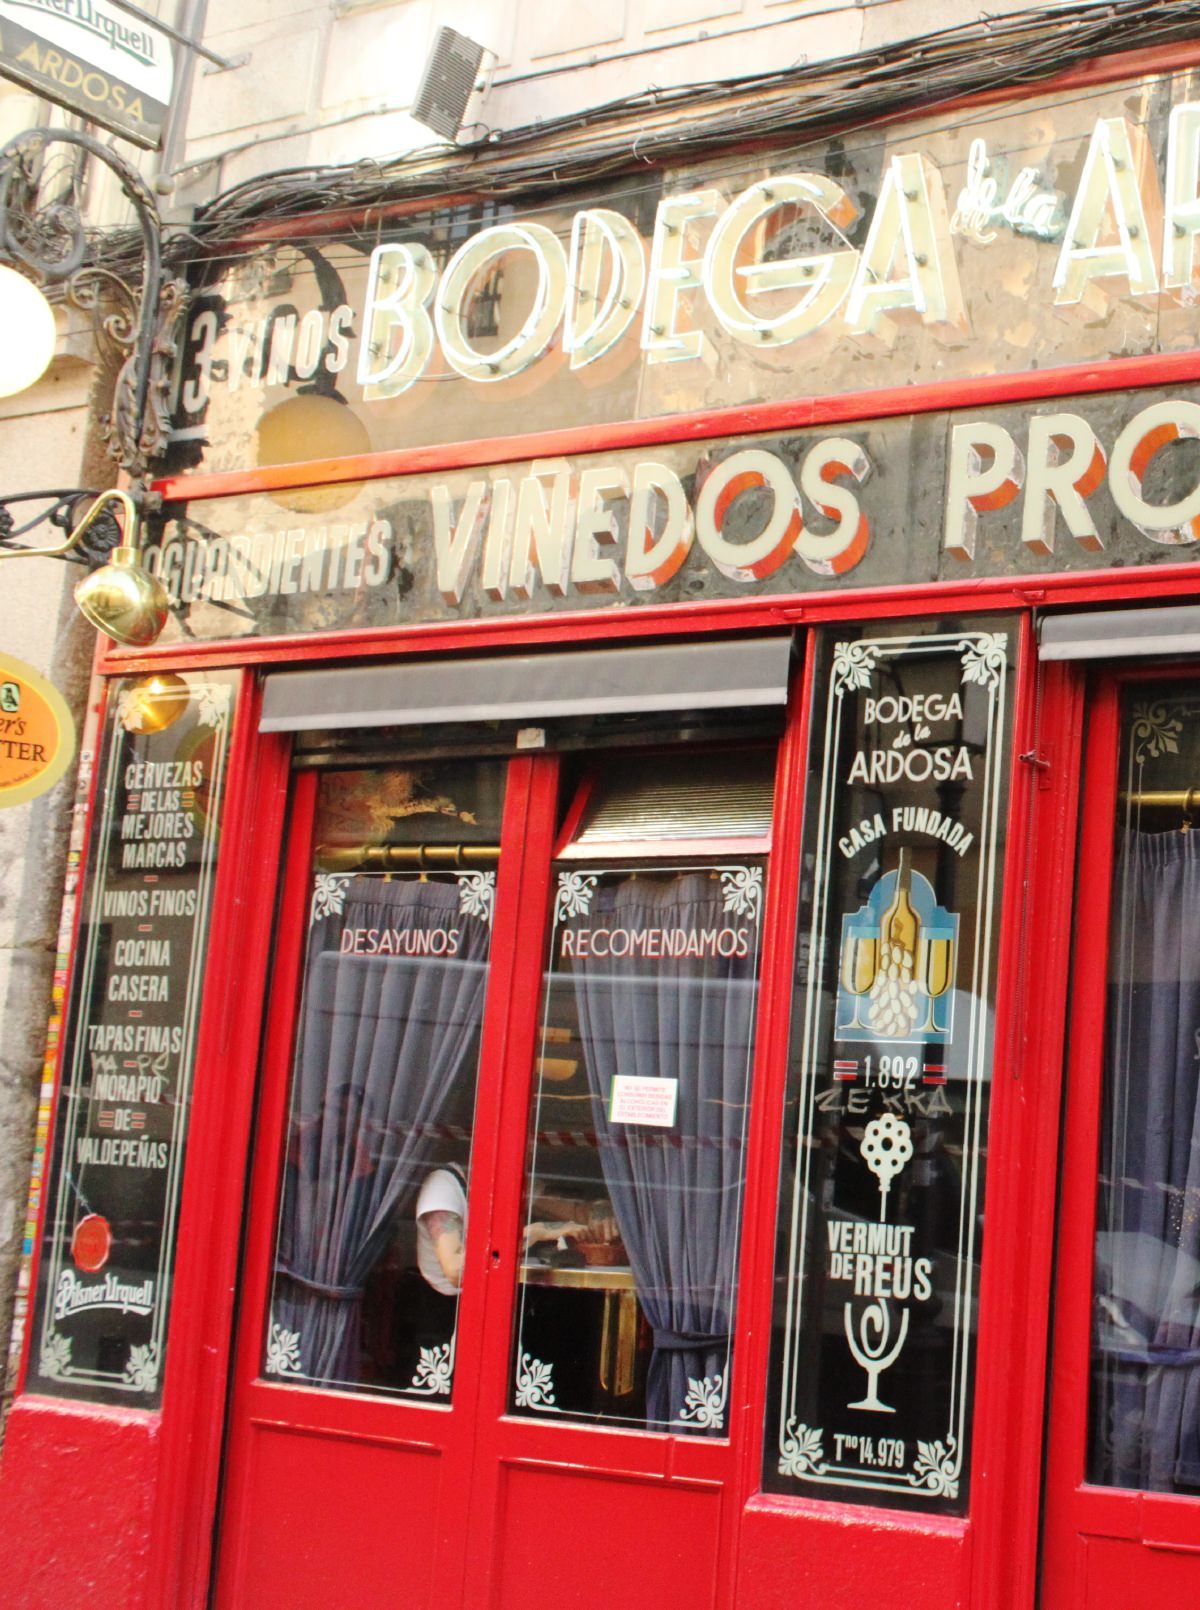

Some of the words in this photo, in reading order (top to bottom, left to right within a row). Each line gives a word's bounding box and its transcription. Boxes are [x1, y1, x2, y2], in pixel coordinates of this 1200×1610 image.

[16, 40, 145, 121] ARDOSA
[356, 153, 952, 400] BODEGA
[227, 304, 354, 393] VINOS
[431, 437, 872, 601] VIÑEDOS
[864, 692, 963, 724] BODEGA
[125, 761, 204, 790] CERVEZAS
[847, 745, 974, 785] ARDOSA
[141, 791, 155, 812] DE
[157, 790, 181, 812] LAS
[121, 812, 195, 840] MEJORES
[838, 813, 887, 859] CASA
[892, 806, 974, 857] FUNDADA
[122, 842, 187, 869] MARCAS
[103, 890, 149, 917] VINOS
[150, 889, 197, 917] FINOS
[114, 940, 170, 967] COCINA
[340, 927, 459, 956] DESAYUNOS
[561, 927, 750, 958] RECOMENDAMOS
[108, 975, 169, 1002] CASERA
[88, 1025, 135, 1052] TAPAS
[135, 1026, 183, 1053] FINAS
[864, 1054, 919, 1090] 1.892
[95, 1074, 161, 1103] MORAPIO
[114, 1109, 131, 1131] DE
[77, 1135, 168, 1169] VALDEPEÑAS
[827, 1220, 915, 1257] VERMUT
[830, 1252, 854, 1280] DE
[854, 1255, 932, 1301] REUS
